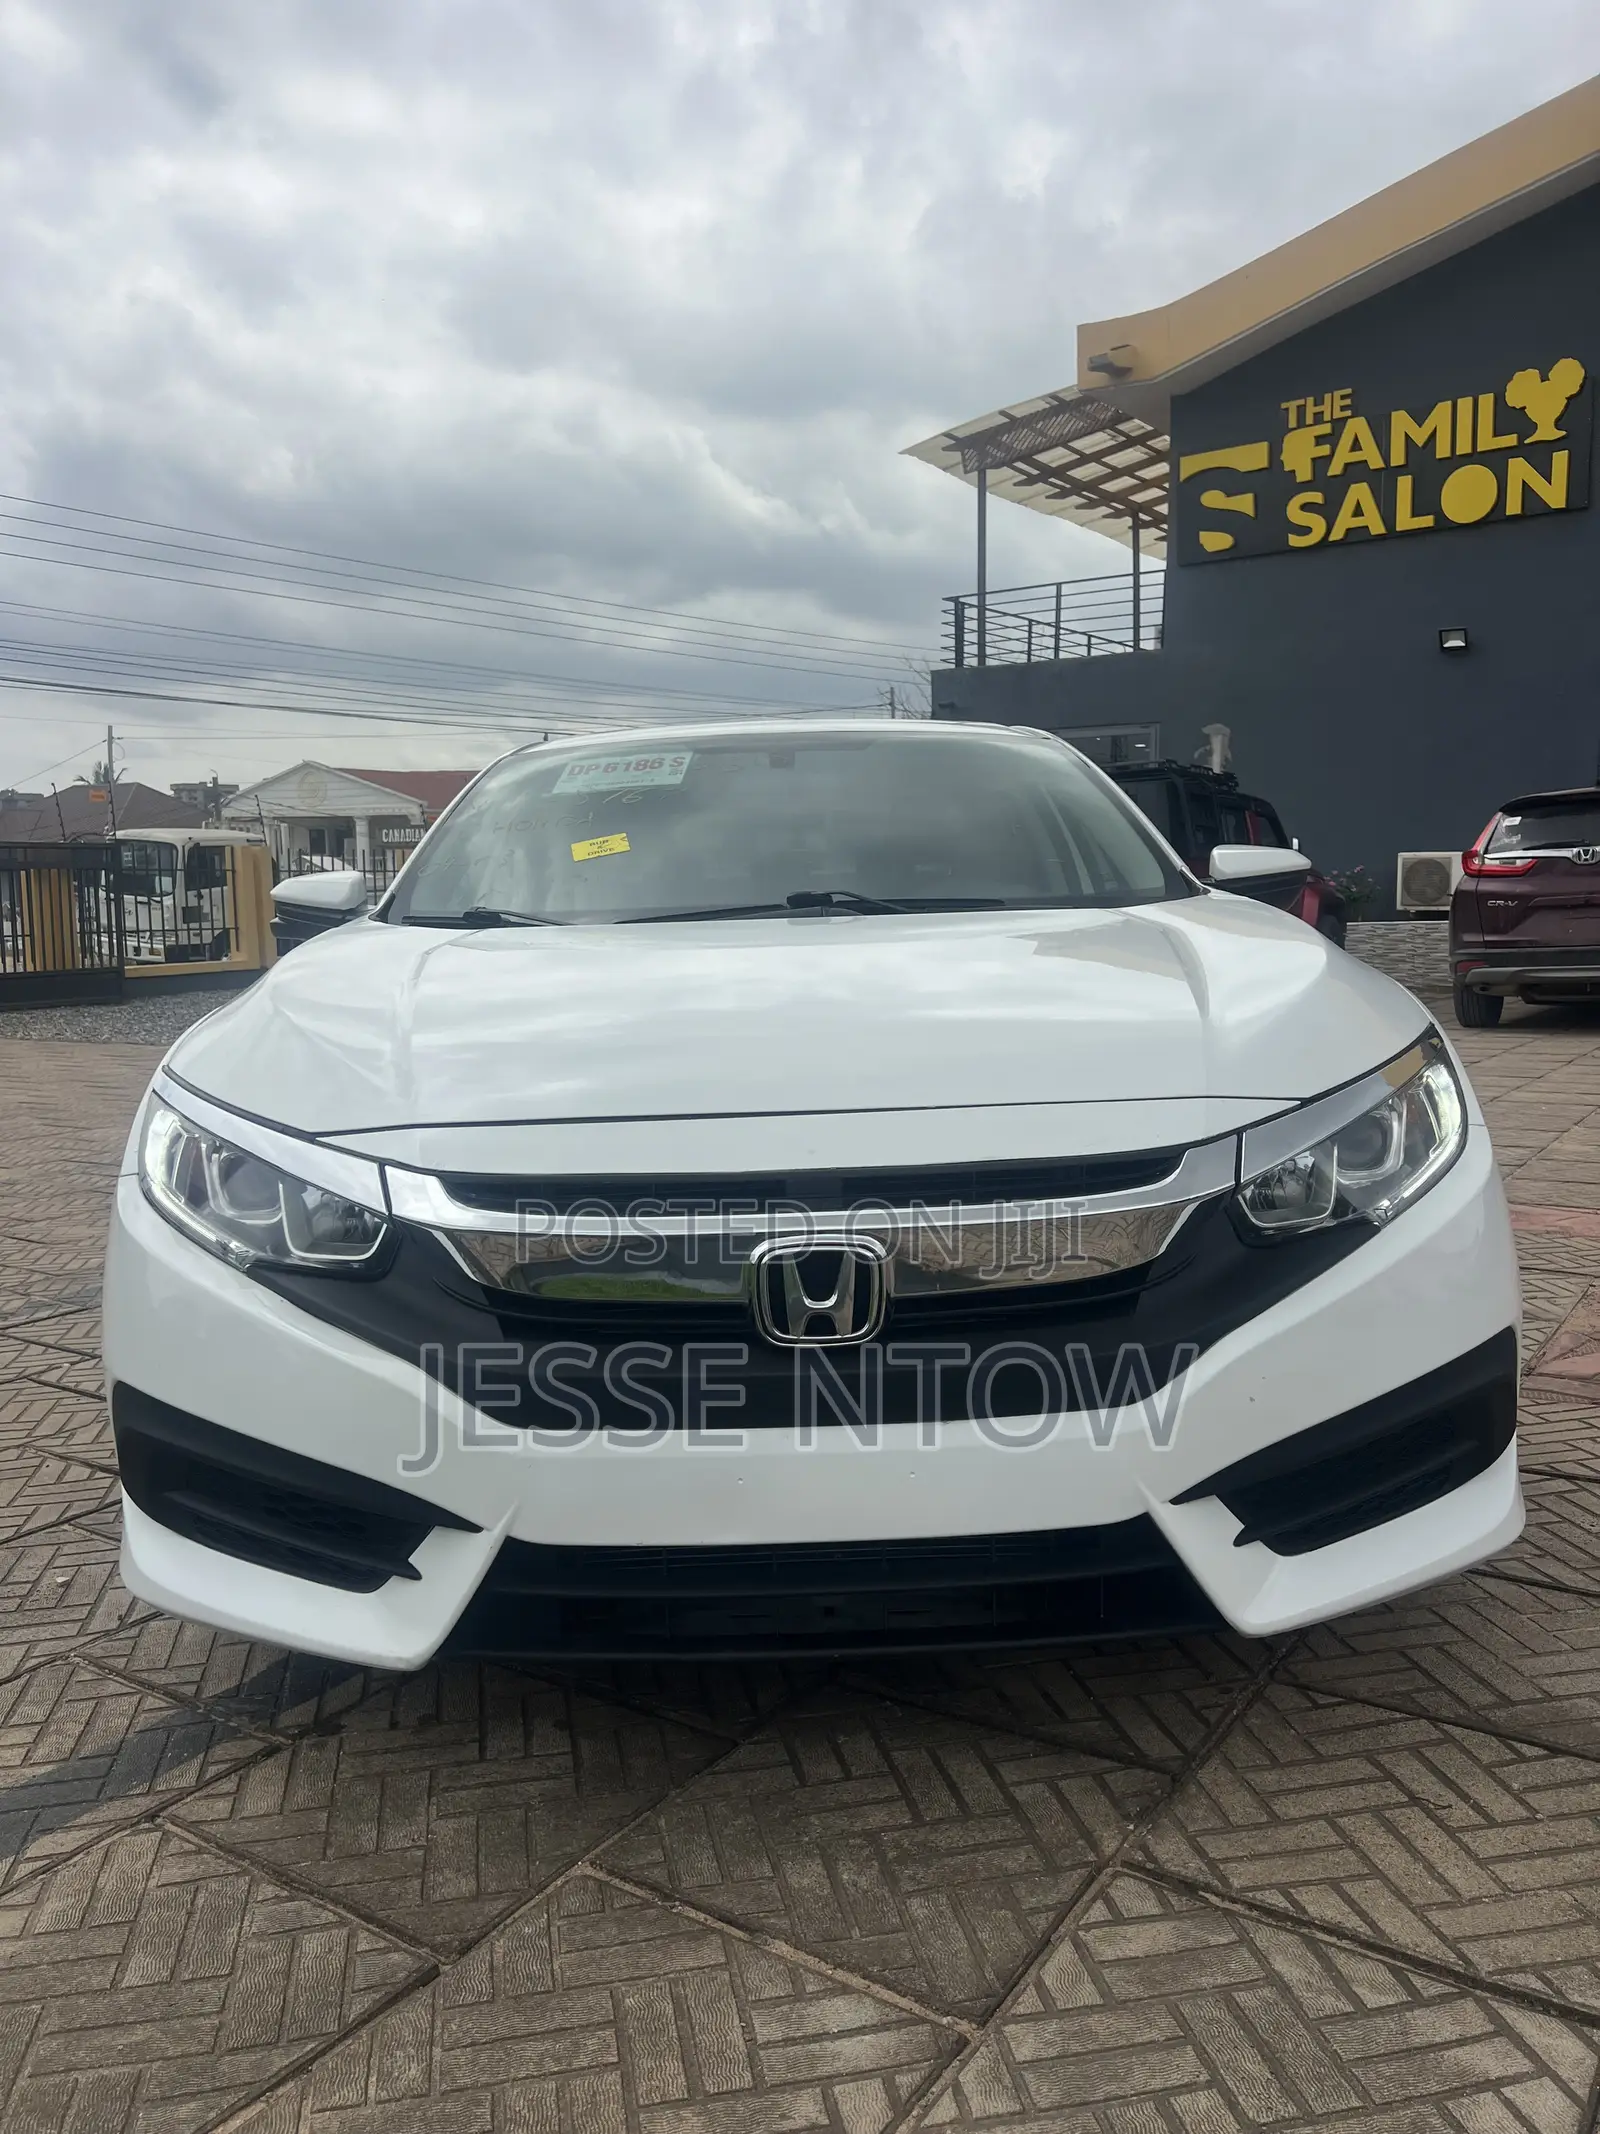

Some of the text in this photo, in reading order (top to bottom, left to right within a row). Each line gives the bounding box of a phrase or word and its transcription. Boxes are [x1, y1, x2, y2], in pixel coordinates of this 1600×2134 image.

[1280, 388, 1353, 428] THE
[1286, 450, 1570, 548] SALON
[566, 764, 600, 776] DP
[601, 757, 666, 774] 6186
[668, 756, 687, 768] S
